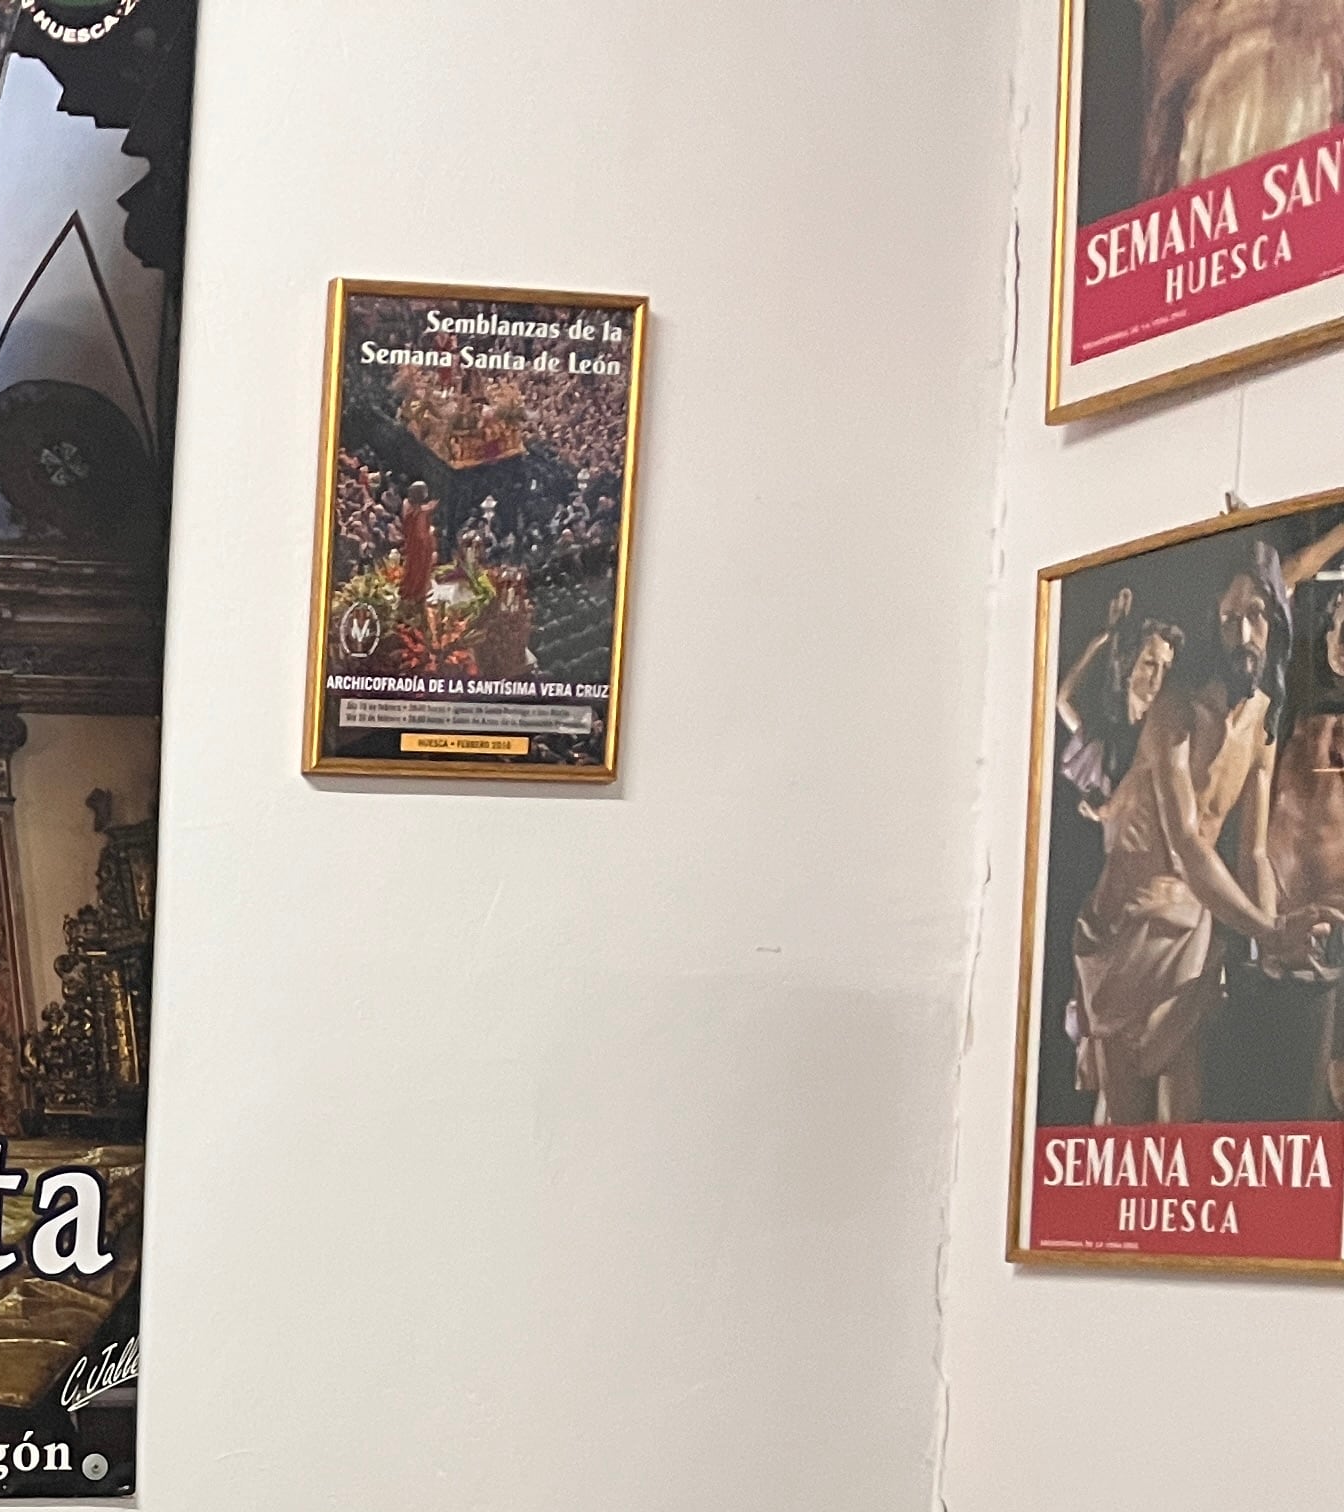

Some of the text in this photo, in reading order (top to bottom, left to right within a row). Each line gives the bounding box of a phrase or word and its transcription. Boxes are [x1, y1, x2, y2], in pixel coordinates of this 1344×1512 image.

[33, 10, 119, 42] HUESCA
[1085, 141, 1344, 286] SEMANA SAN
[1166, 230, 1291, 303] HUESCA
[425, 310, 622, 342] Semblanzas de la
[361, 341, 621, 375] Semana Santa de León
[327, 675, 610, 699] ARCHICOFRADÍA DE LA SANTÍSIMA VERA CRUZ
[1044, 1135, 1332, 1188] SEMANA SANTA
[1119, 1198, 1238, 1234] HUESCA
